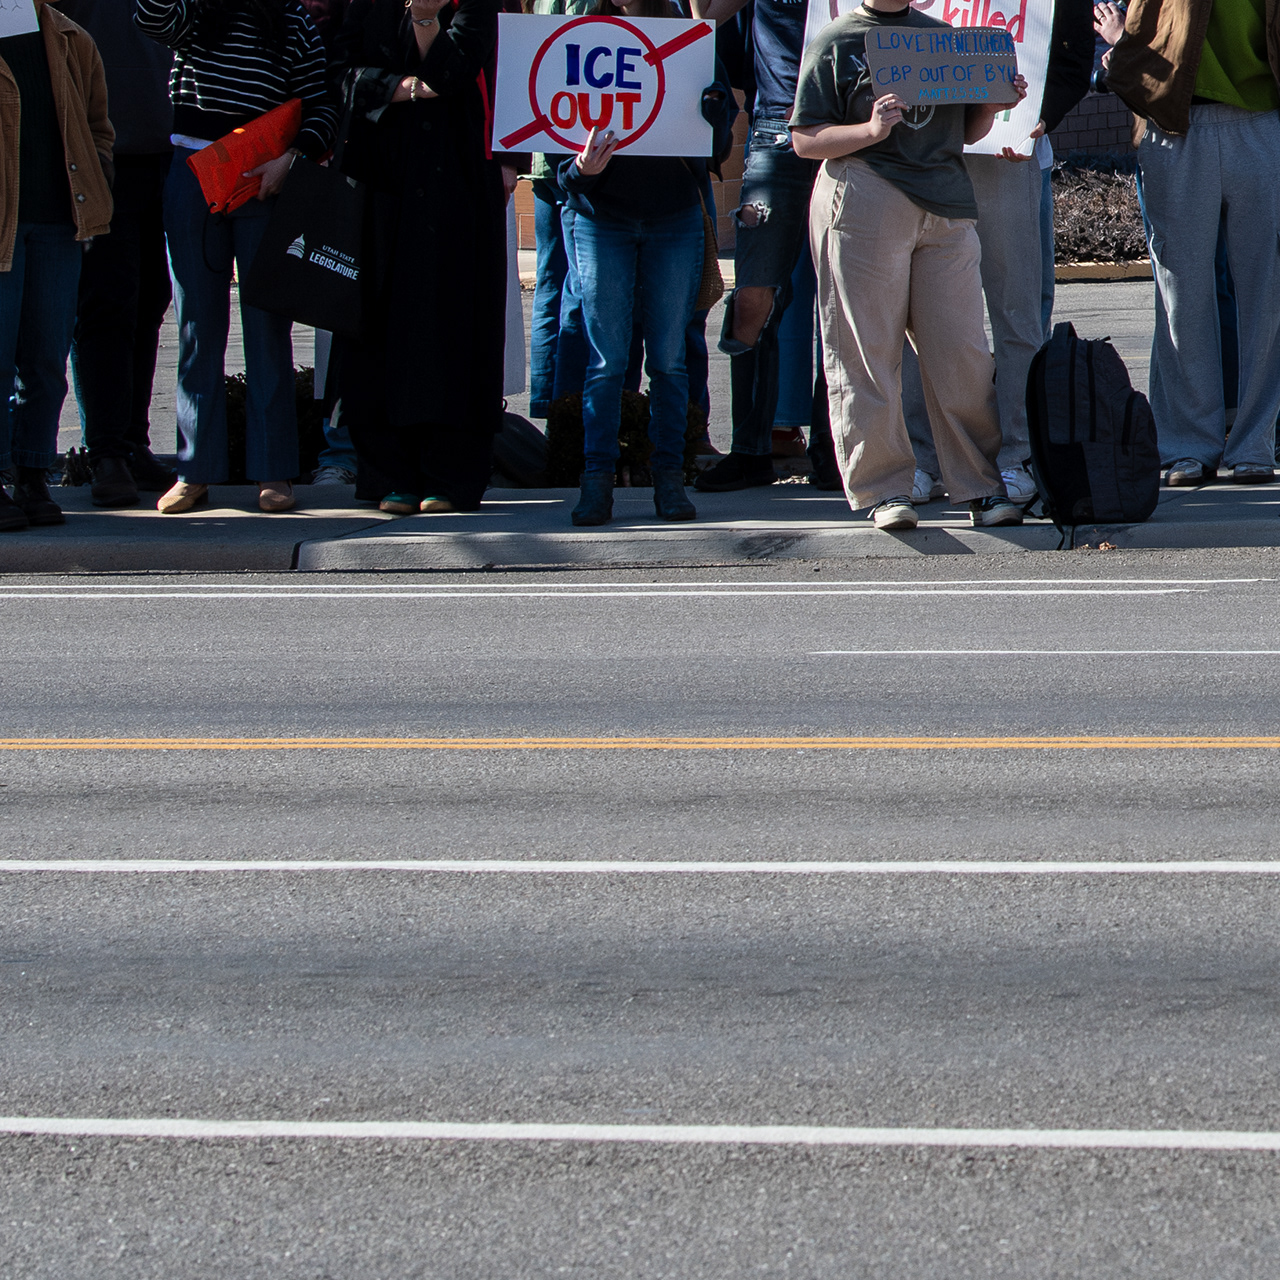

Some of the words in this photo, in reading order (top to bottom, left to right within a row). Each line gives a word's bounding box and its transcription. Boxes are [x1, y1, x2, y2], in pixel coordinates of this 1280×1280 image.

[876, 32, 926, 53] LOVE
[928, 32, 953, 54] THY
[565, 43, 642, 90] ICE
[875, 65, 911, 86] CBP
[919, 64, 949, 83] OUT
[952, 64, 976, 82] OF
[984, 63, 1017, 84] BYU
[918, 87, 949, 101] MATT
[550, 90, 642, 133] OUT
[309, 251, 359, 281] LEGISLATURE
